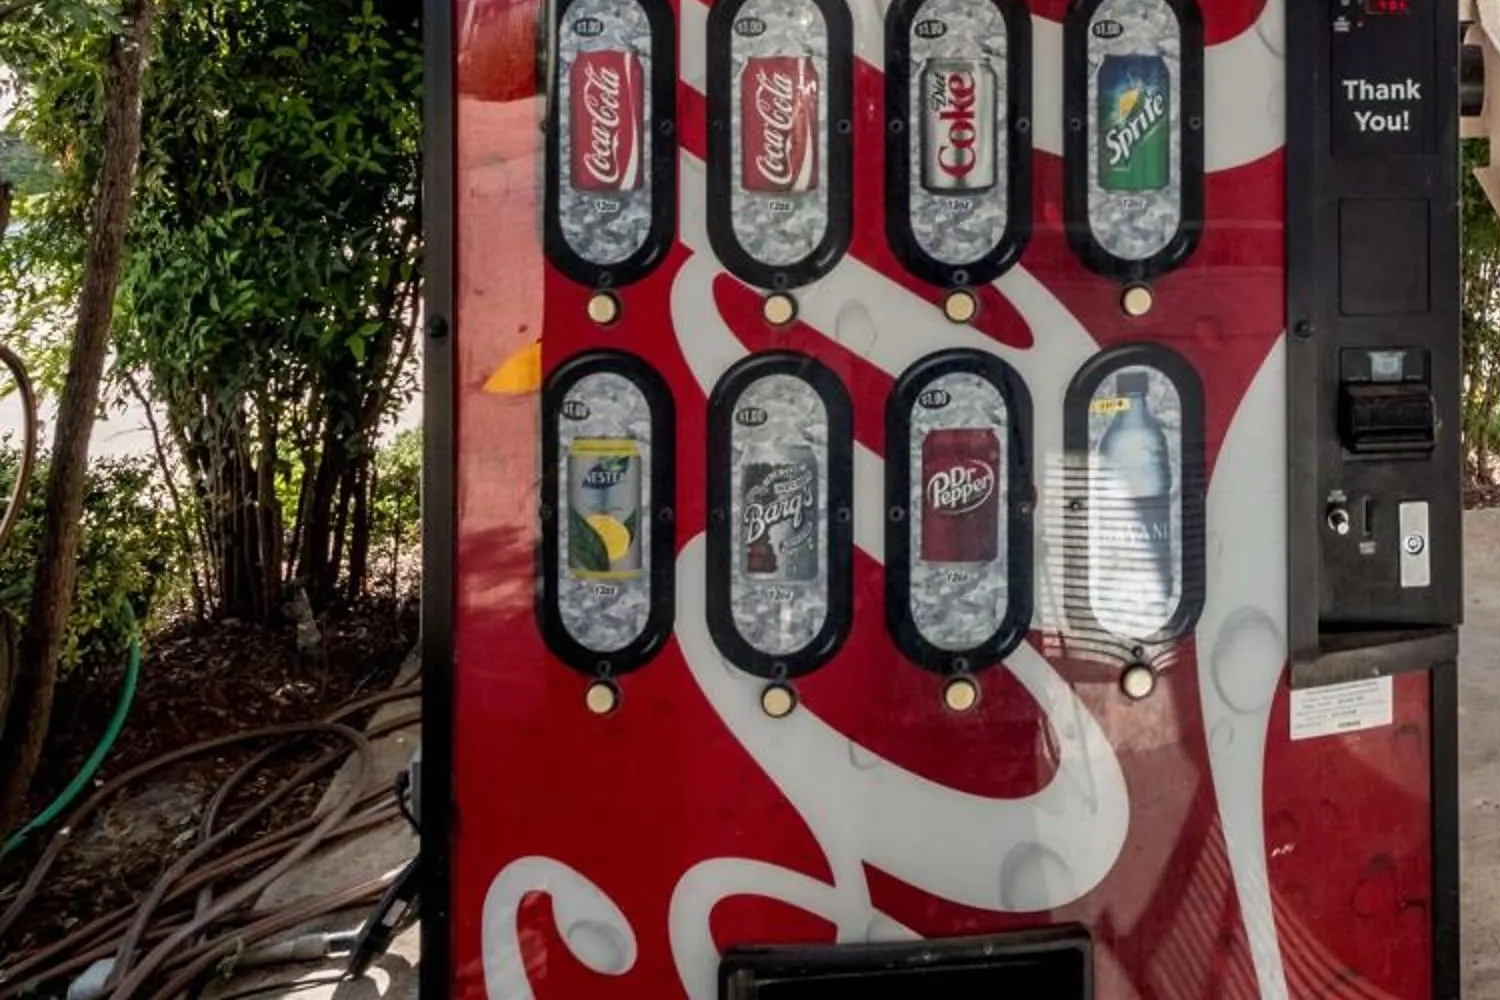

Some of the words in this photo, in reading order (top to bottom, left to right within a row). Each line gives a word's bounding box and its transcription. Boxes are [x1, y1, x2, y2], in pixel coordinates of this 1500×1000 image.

[1343, 78, 1422, 101] Thank
[937, 72, 977, 179] Coke
[1106, 92, 1165, 166] Sprite
[1354, 112, 1410, 132] You!
[930, 472, 991, 510] Pepper
[950, 466, 977, 487] Dr
[744, 483, 813, 544] Barq's
